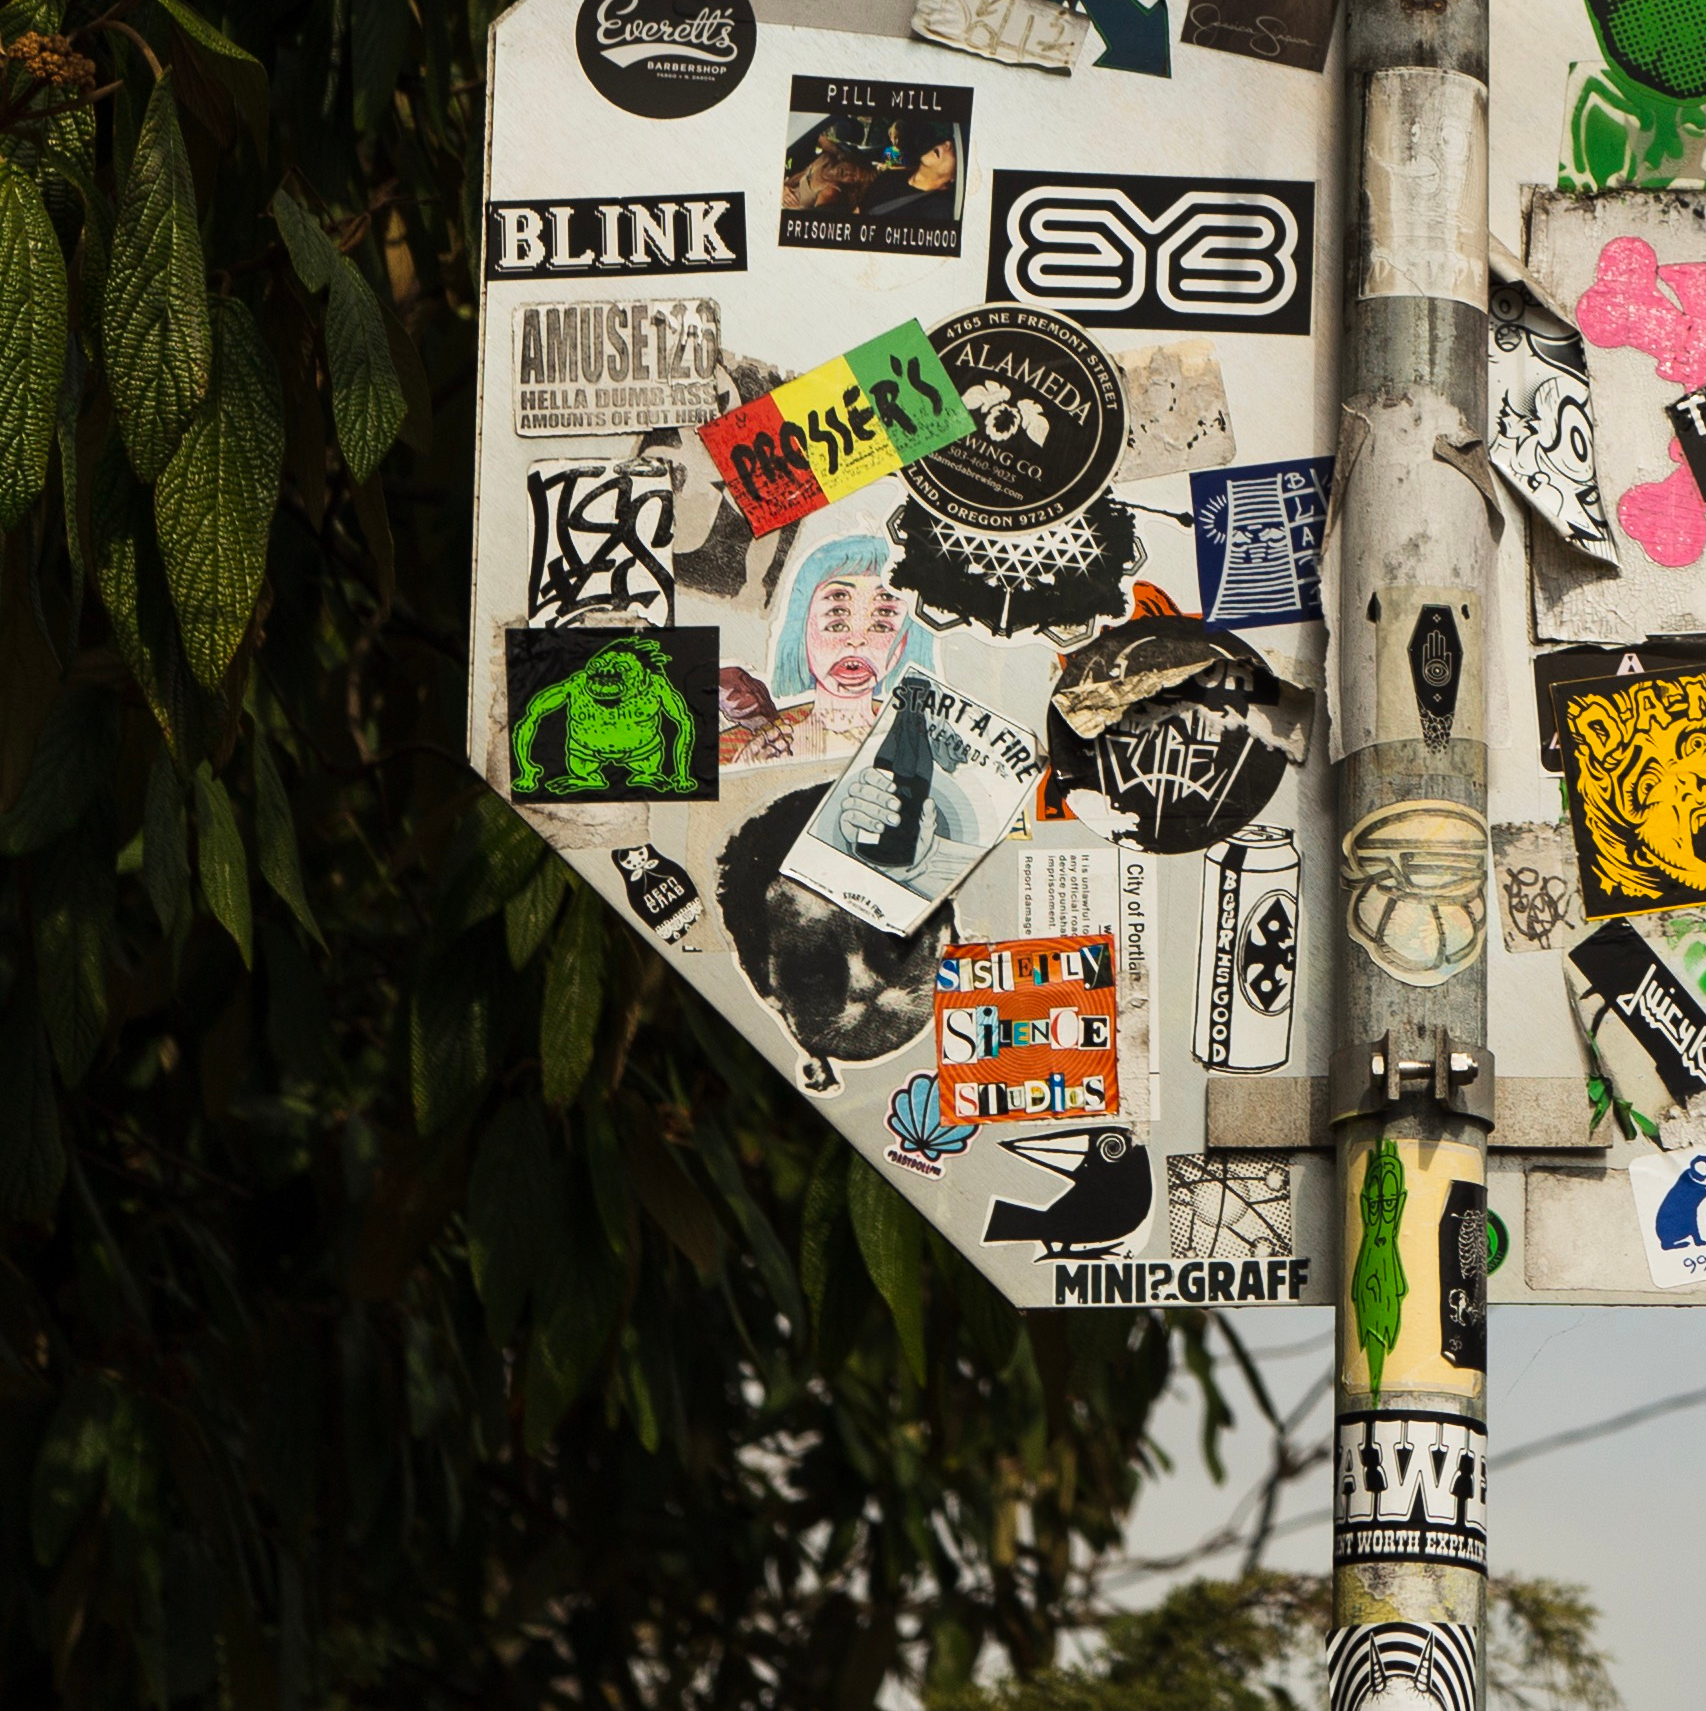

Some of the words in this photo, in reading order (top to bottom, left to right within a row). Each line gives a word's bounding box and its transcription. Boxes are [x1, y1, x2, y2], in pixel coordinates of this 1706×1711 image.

[647, 61, 728, 75] BARBERSHOP
[827, 84, 876, 107] PILL
[891, 90, 942, 111] MILL
[494, 200, 736, 272] BLINK
[787, 219, 851, 242] PRISONER
[860, 225, 877, 243] OF
[885, 226, 957, 248] CHILDHOOD
[946, 316, 982, 339] 4765
[988, 312, 1010, 325] NE
[1017, 313, 1089, 354] FREMONT
[1087, 354, 1118, 411] STREET
[521, 389, 588, 411] HELLA
[955, 342, 1092, 427] ALAMEDA
[520, 409, 607, 430] AMOUNTS
[611, 408, 633, 428] OF
[675, 405, 718, 426] HERE
[730, 354, 943, 502] PROSSER'S
[948, 445, 1017, 484] 503-460-9025
[955, 433, 1014, 468] WING
[1016, 459, 1043, 482] CO.
[908, 462, 941, 507] LAND,
[947, 502, 1014, 528] OREGON
[1018, 502, 1065, 527] 97213
[577, 710, 596, 722] OH
[891, 684, 974, 724] START
[968, 713, 993, 738] A
[990, 727, 1043, 785] FIRE
[927, 722, 991, 769] RECORDS
[1023, 855, 1034, 893] Report
[1058, 854, 1068, 889] device
[1068, 854, 1078, 874] any
[1081, 854, 1090, 863] It
[1081, 865, 1090, 874] is
[1070, 876, 1079, 914] official
[1123, 863, 1144, 897] City
[1024, 894, 1034, 936] damage
[1081, 876, 1091, 921] unlawful
[1127, 900, 1145, 918] of
[1357, 1529, 1421, 1555] WORTH
